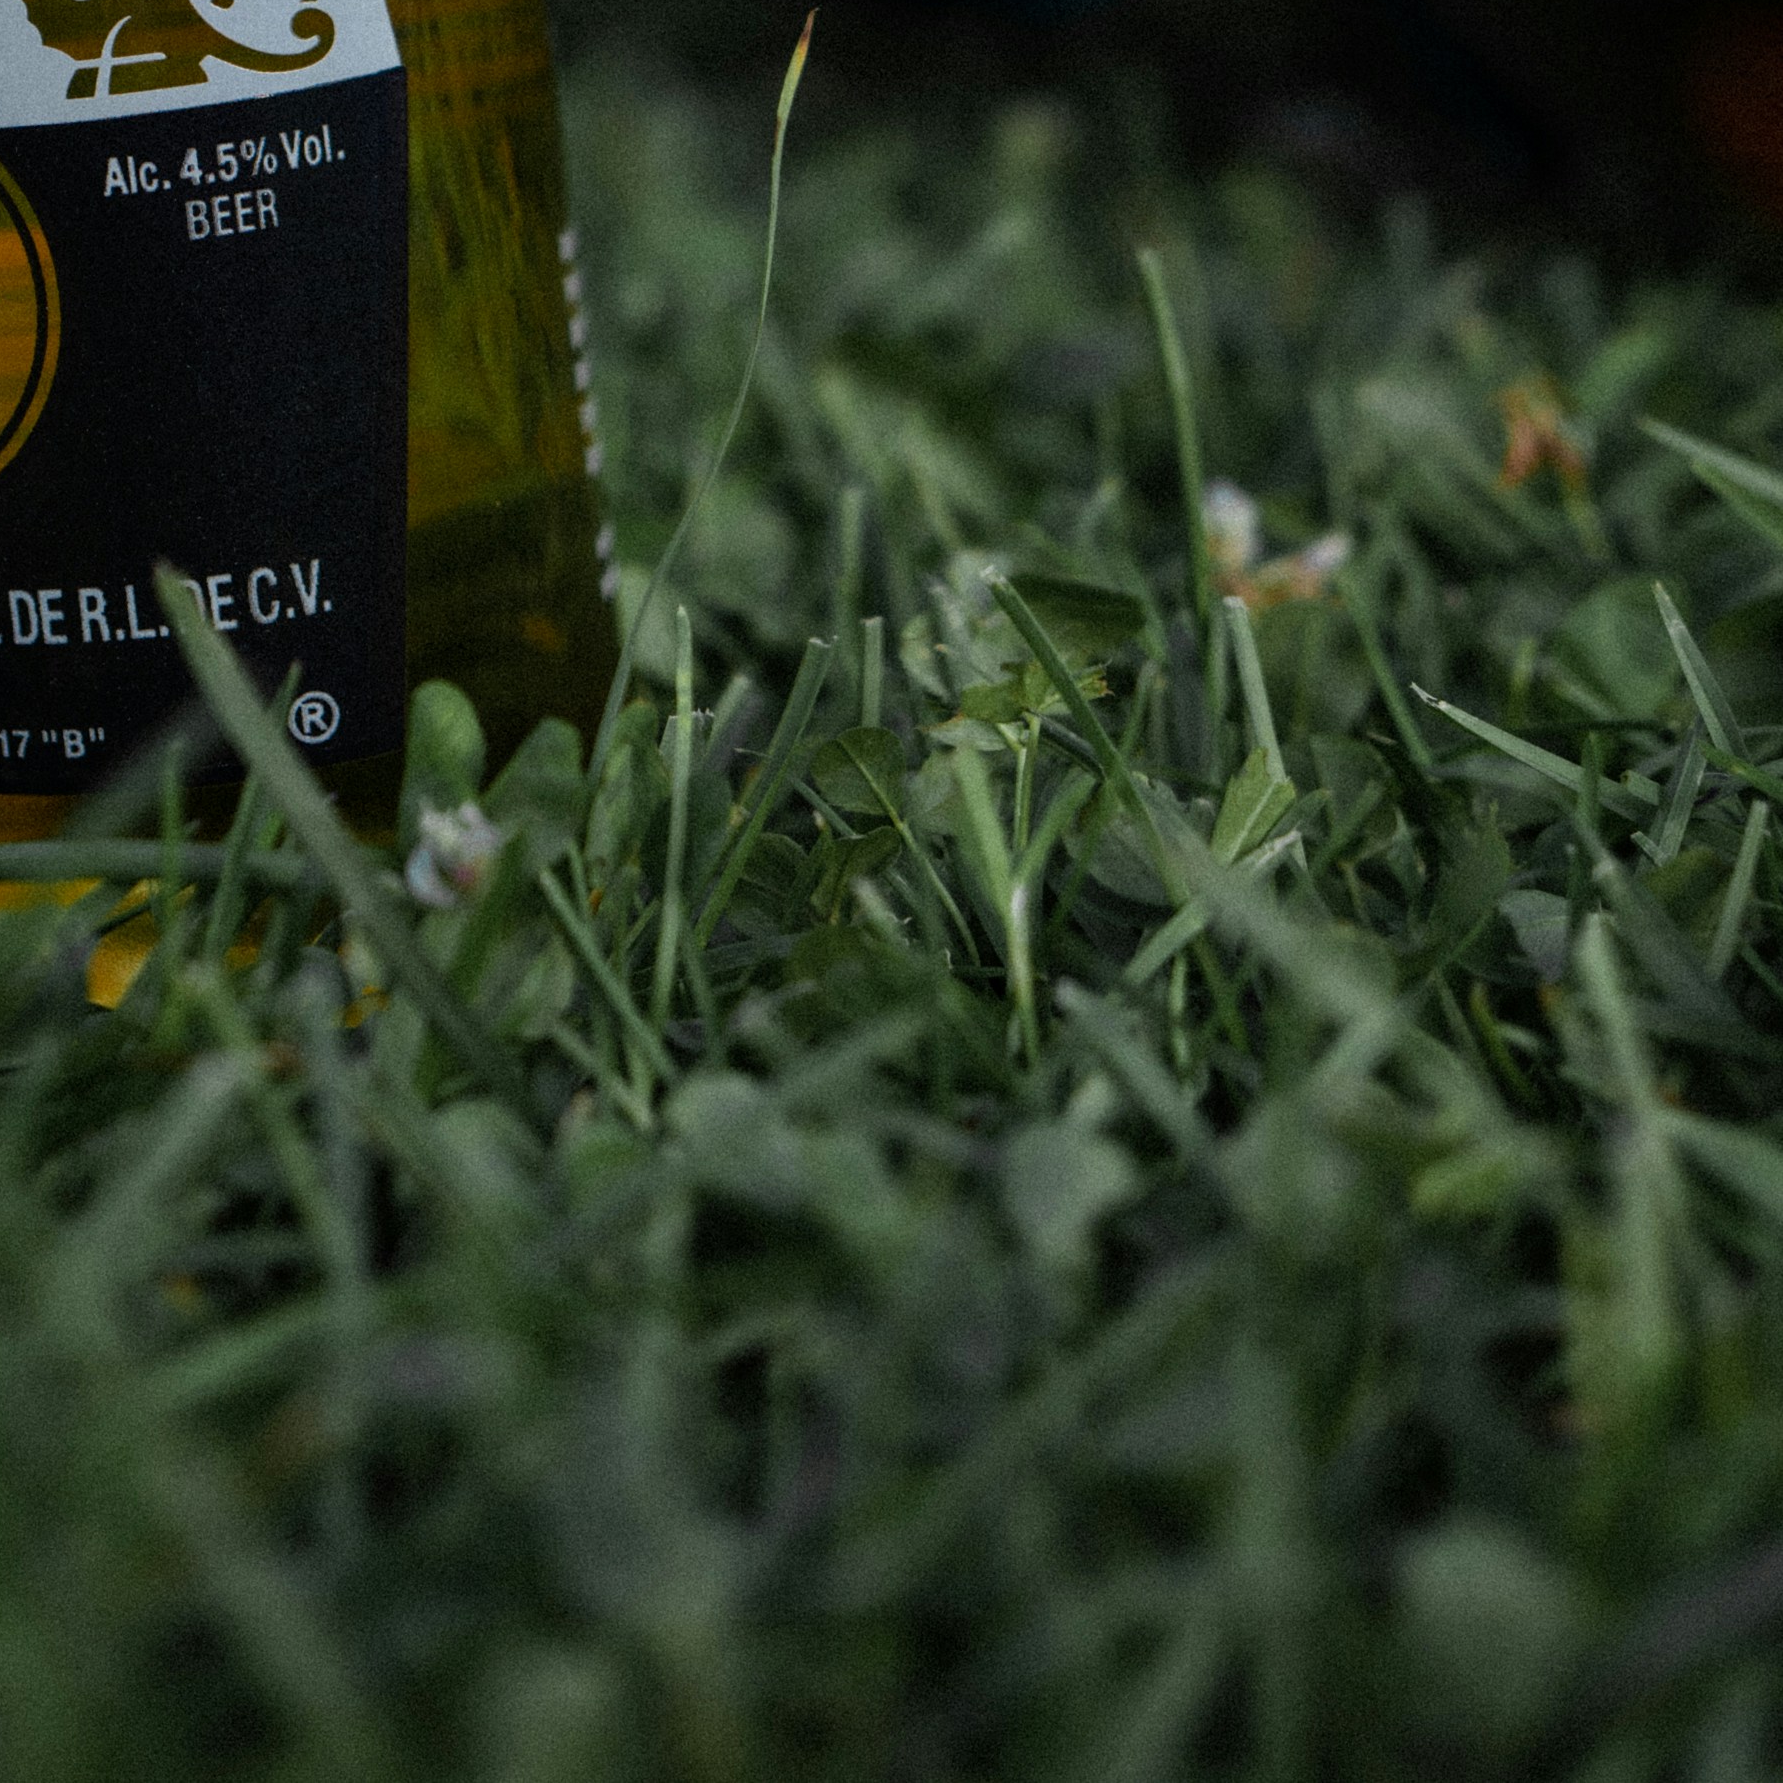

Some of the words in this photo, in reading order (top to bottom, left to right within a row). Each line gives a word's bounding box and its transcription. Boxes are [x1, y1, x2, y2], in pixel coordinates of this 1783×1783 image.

[103, 154, 172, 198] Alc.
[179, 135, 278, 186] 4.5%
[278, 123, 346, 170] Vol.
[184, 187, 280, 242] BEER
[7, 587, 69, 646] DE
[78, 584, 170, 643] R.L.
[247, 558, 333, 625] C.V.
